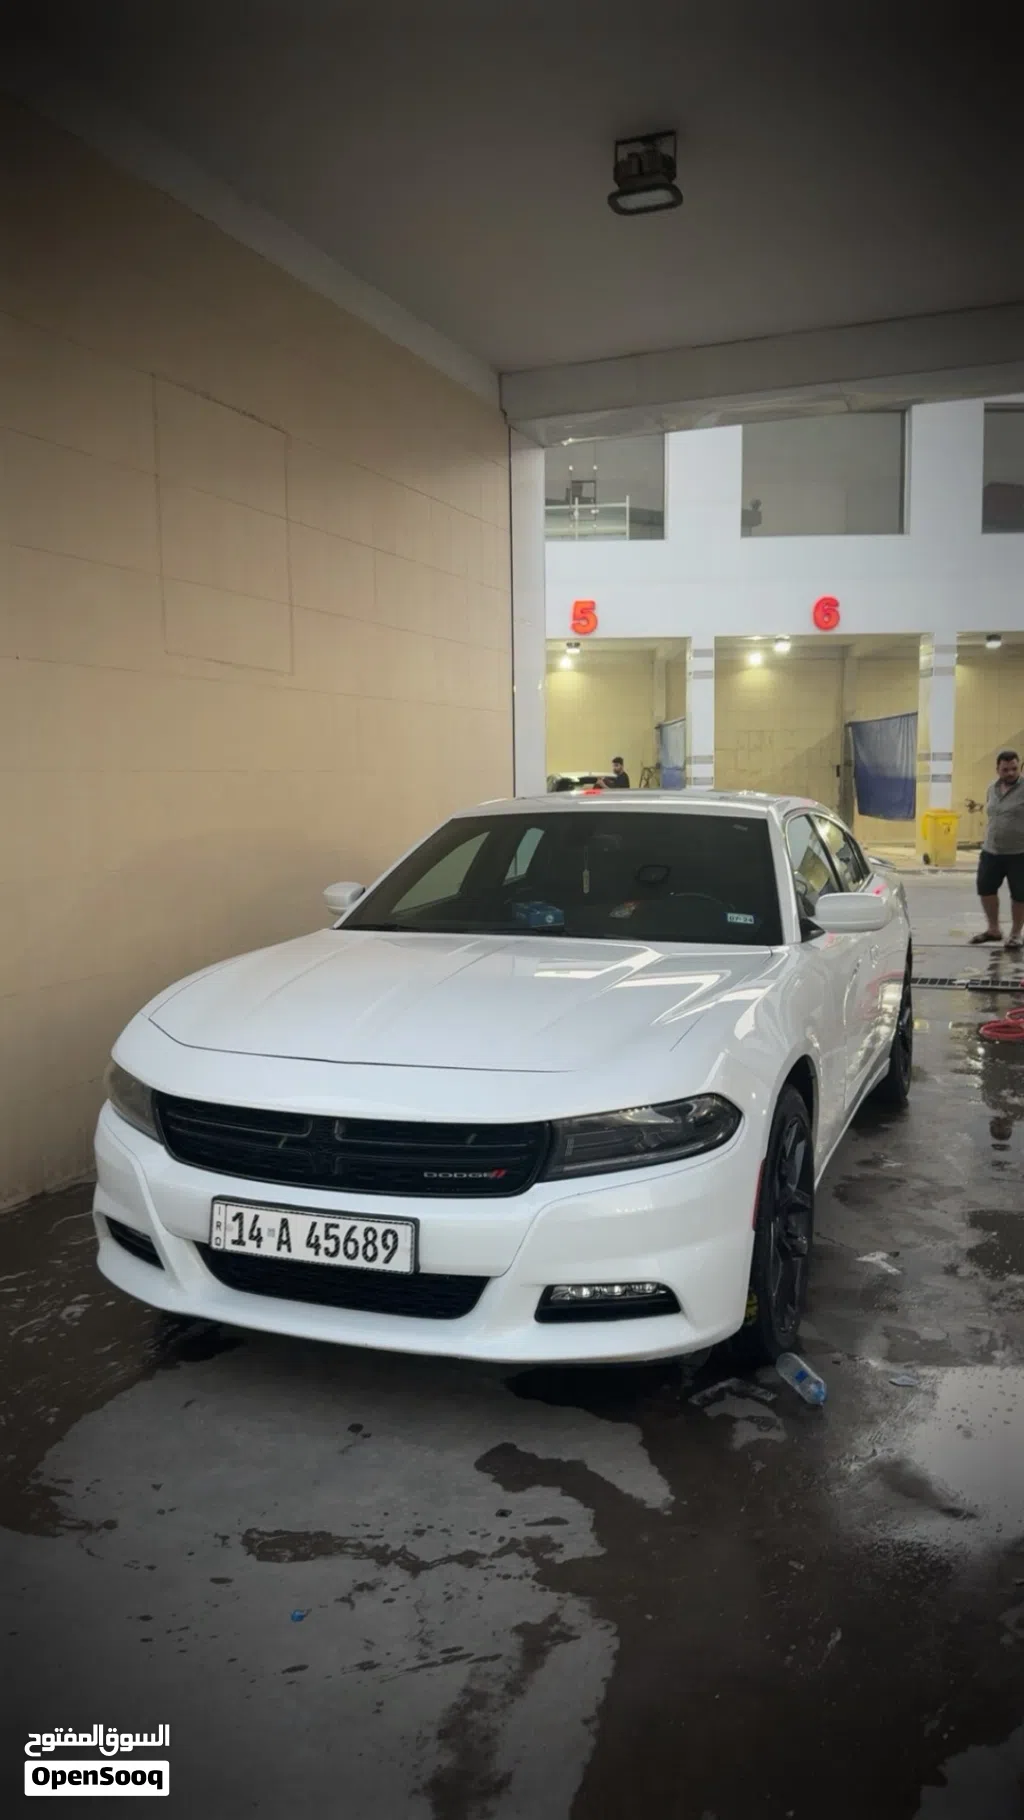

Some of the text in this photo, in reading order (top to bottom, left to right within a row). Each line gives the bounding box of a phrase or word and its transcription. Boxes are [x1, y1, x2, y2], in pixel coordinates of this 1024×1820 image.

[571, 600, 598, 634] 5
[813, 597, 840, 631] 6
[423, 1171, 489, 1179] DODGE
[231, 1211, 400, 1265] 14 A 45689
